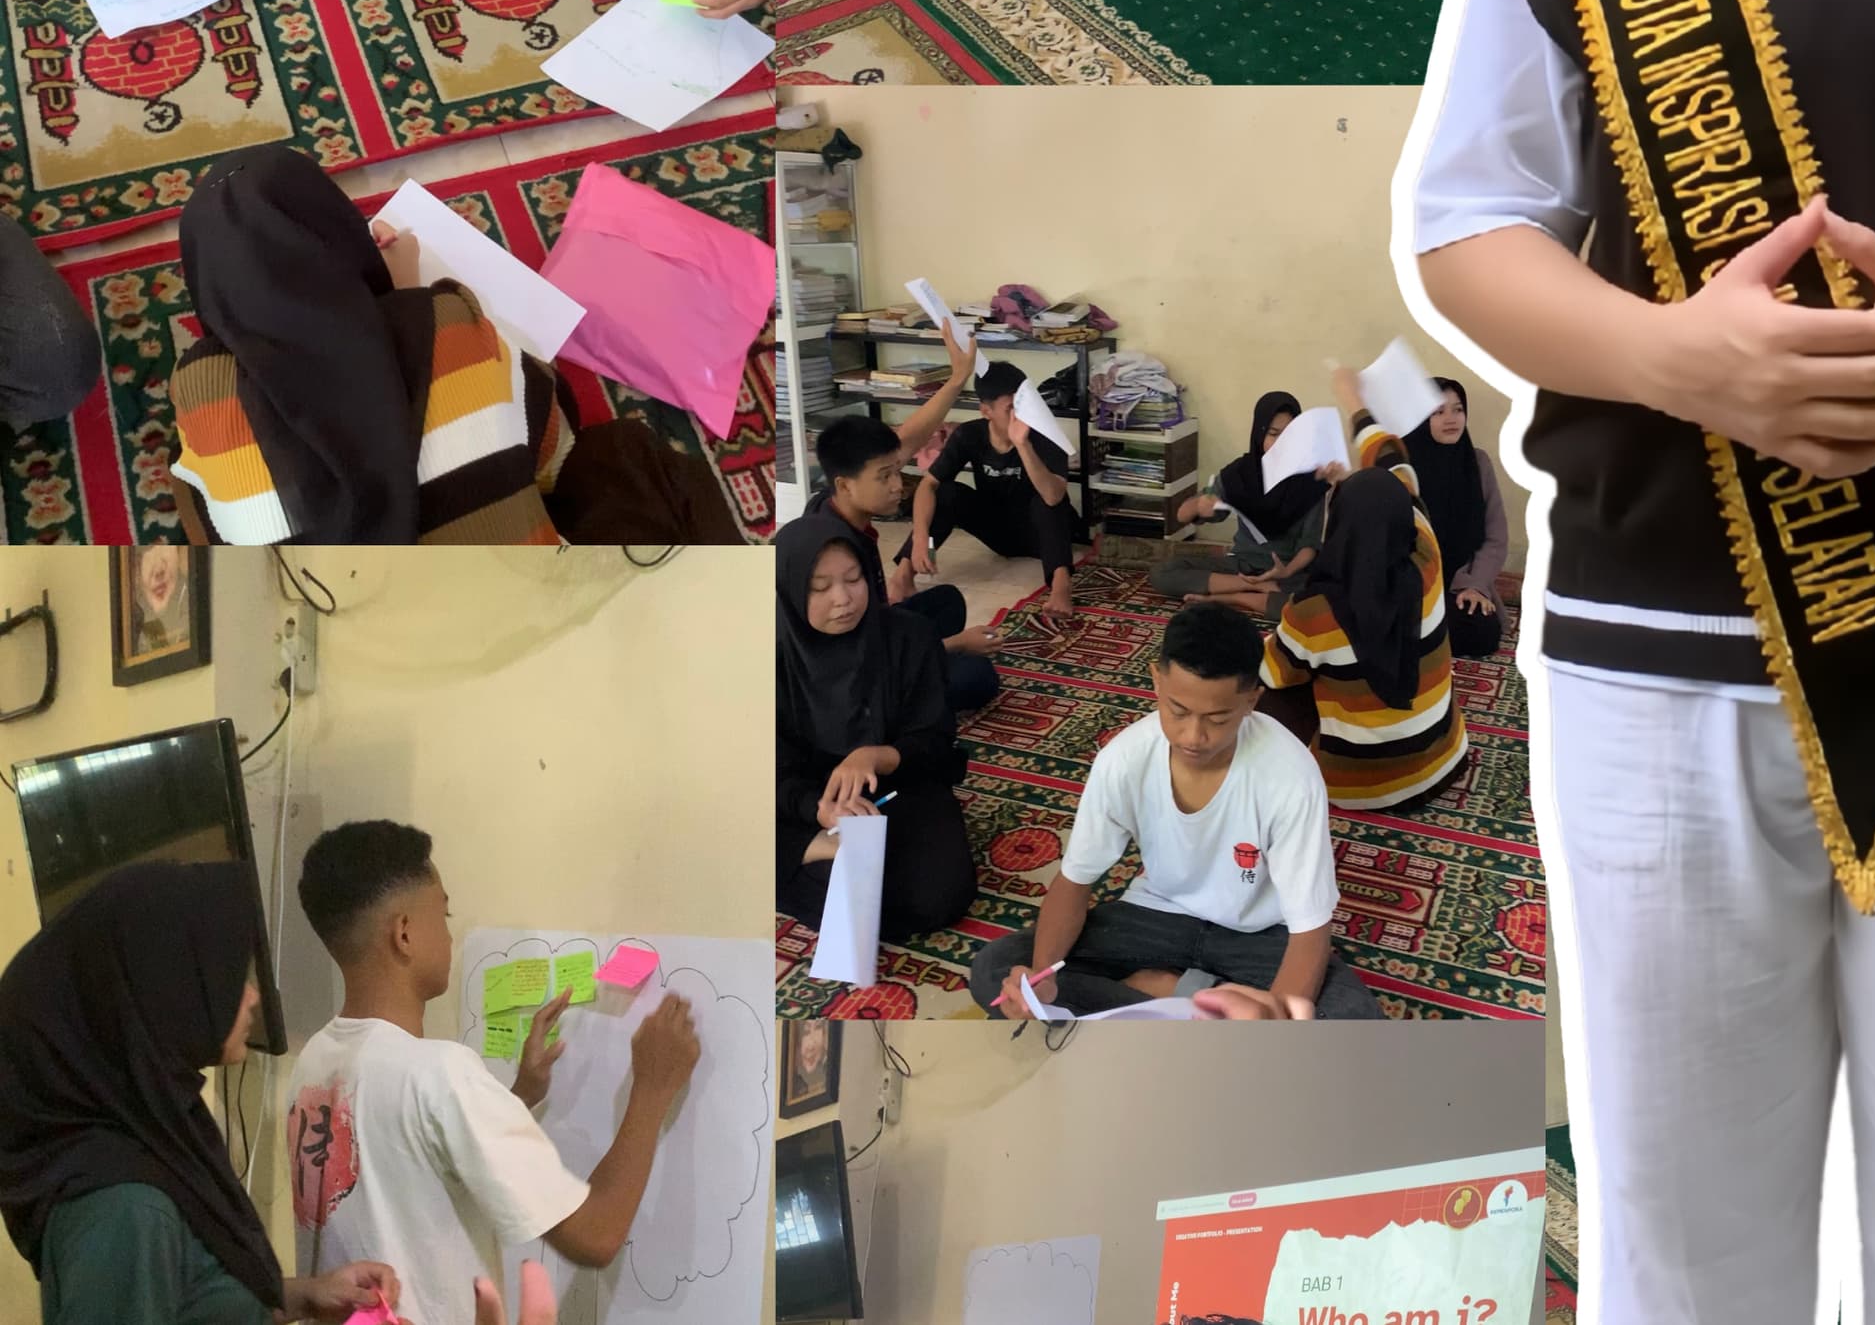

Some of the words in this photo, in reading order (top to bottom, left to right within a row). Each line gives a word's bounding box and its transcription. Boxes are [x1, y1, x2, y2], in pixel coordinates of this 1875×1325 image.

[1639, 42, 1774, 252] INSPIRASI
[1302, 1276, 1331, 1293] BAB
[1336, 1275, 1343, 1290] 1
[1169, 1303, 1178, 1325] out
[1299, 1306, 1369, 1325] Who
[1384, 1309, 1440, 1325] am
